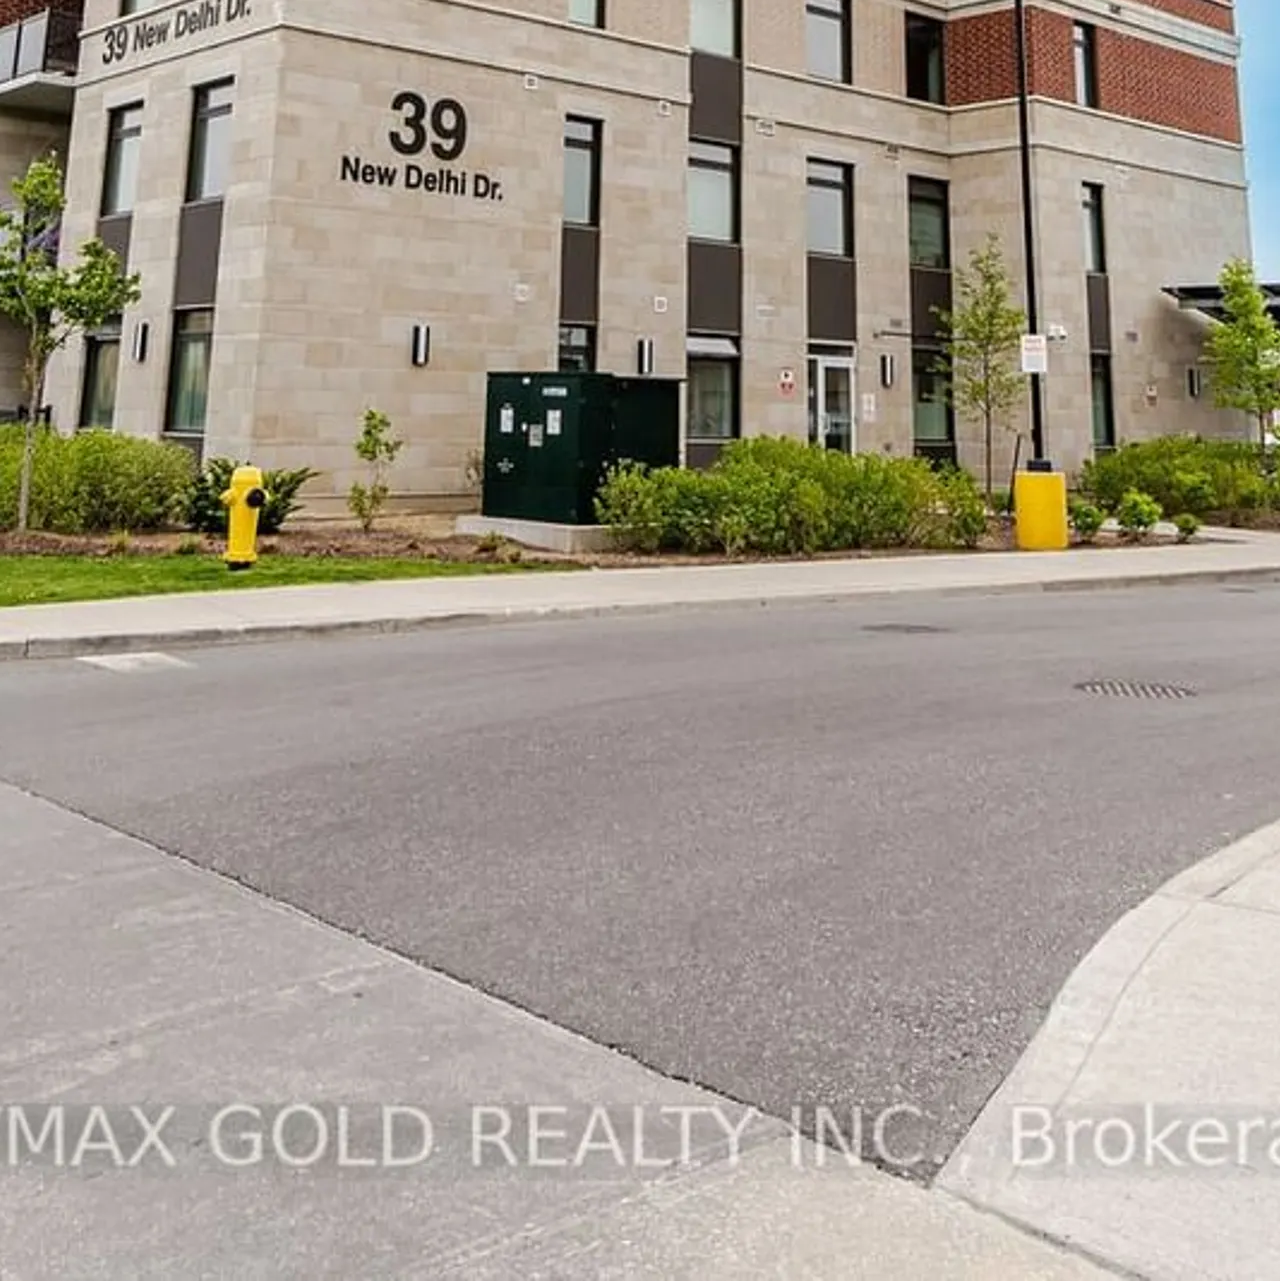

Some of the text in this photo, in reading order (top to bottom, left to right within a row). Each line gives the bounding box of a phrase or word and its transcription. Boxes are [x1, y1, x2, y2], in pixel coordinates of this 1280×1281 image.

[102, 23, 128, 65] 39
[132, 20, 170, 52] New
[388, 91, 467, 161] 39
[340, 155, 503, 201] New Delhi Dr.
